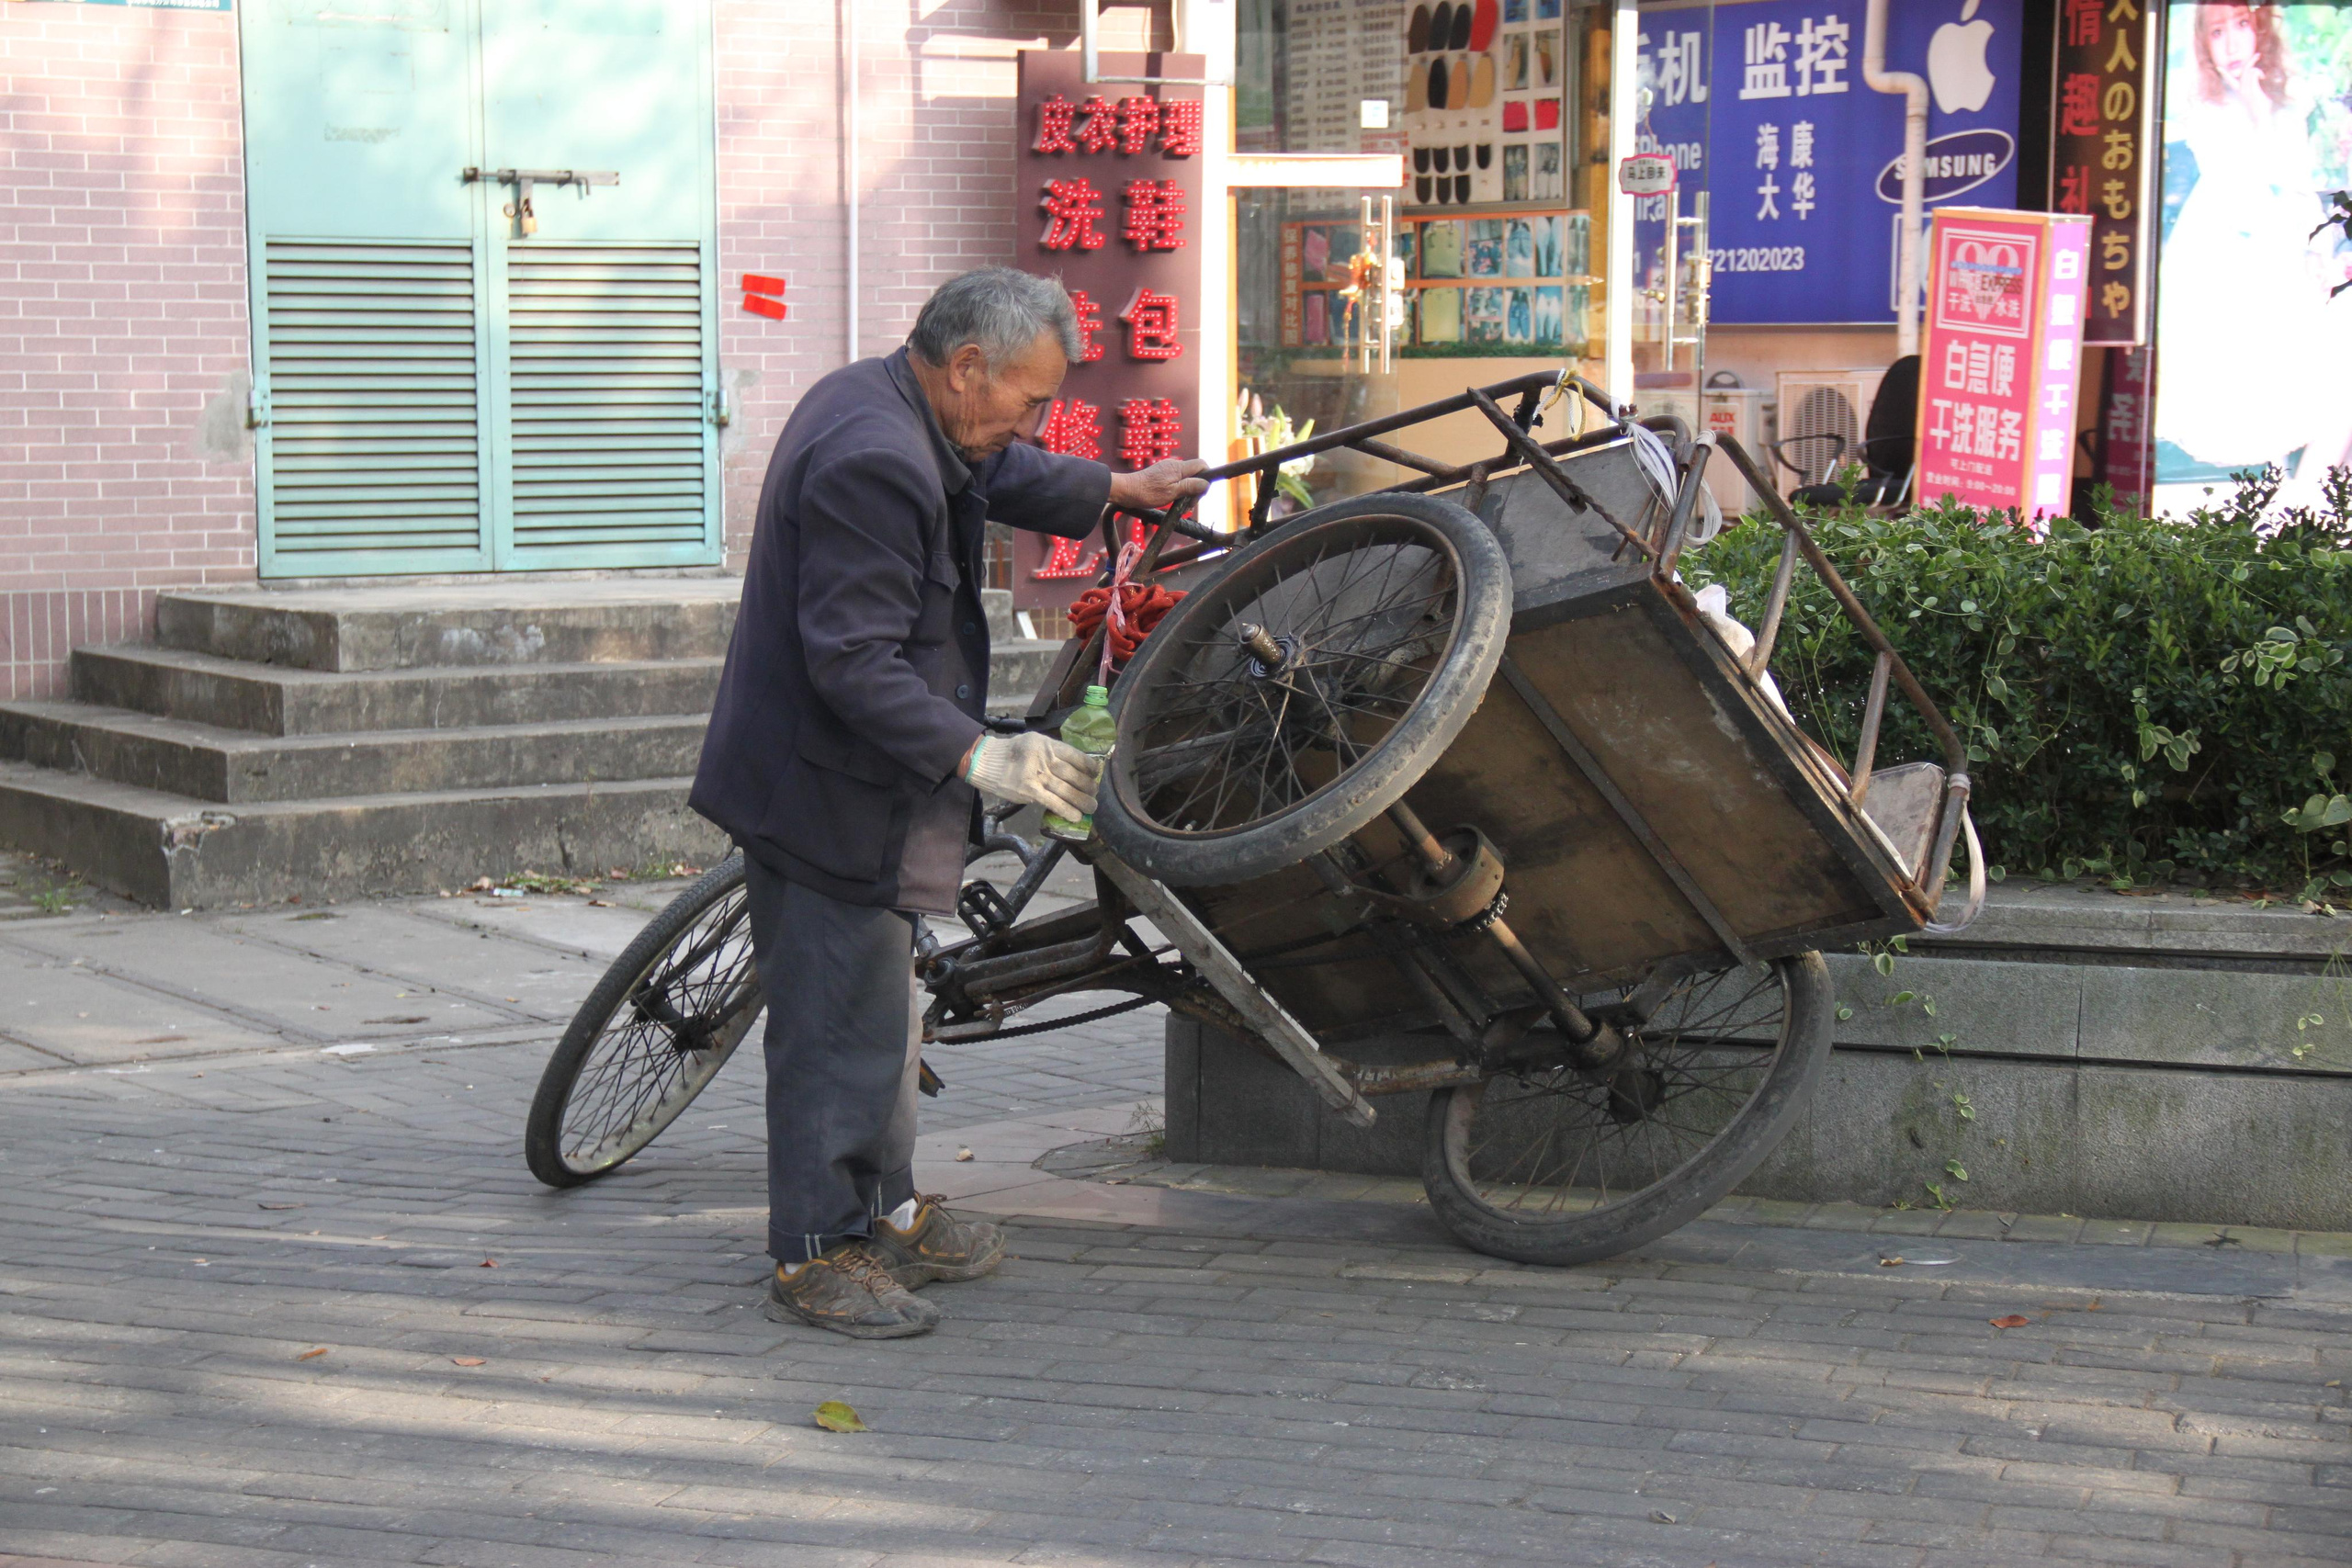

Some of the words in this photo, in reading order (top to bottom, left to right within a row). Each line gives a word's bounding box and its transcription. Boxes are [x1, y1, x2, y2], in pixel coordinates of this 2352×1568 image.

[1739, 15, 1849, 100] 监控
[1035, 94, 1202, 155] 皮衣护理
[1756, 120, 1815, 171] 海康
[1894, 152, 1996, 180] SMSUNG
[1039, 178, 1187, 251] 洗鞋
[1757, 173, 1815, 221] 大华
[1943, 339, 2016, 398] 白急便
[1709, 412, 1736, 423] AUX
[1929, 398, 2022, 462] 干洗服务
